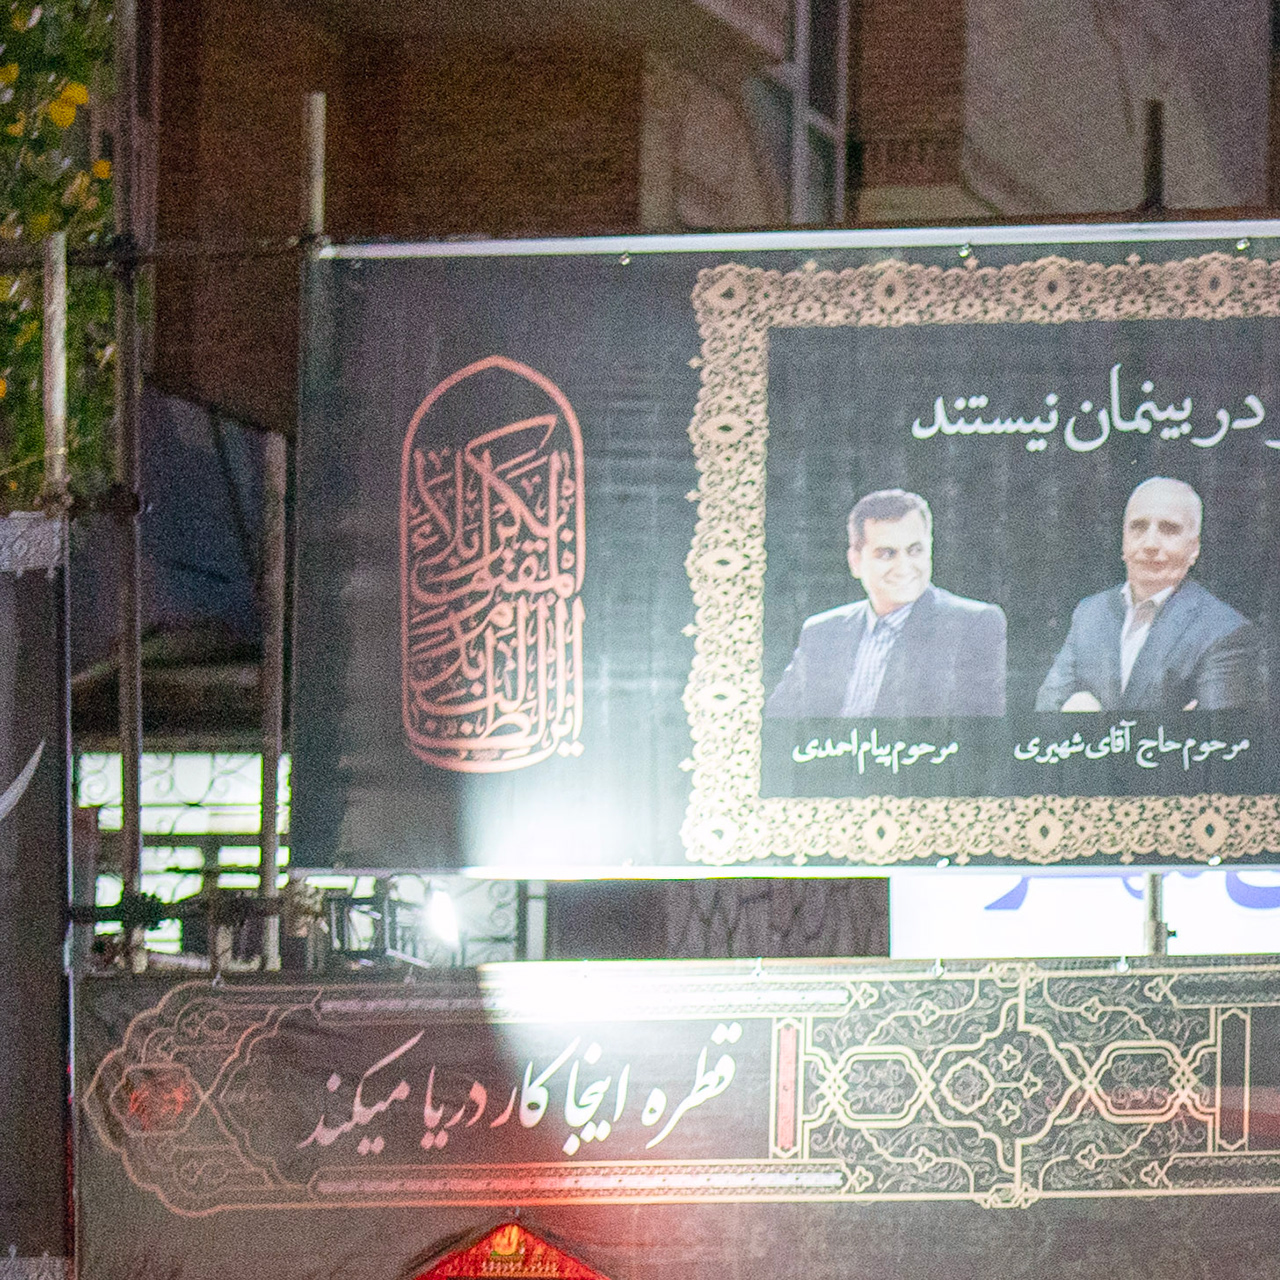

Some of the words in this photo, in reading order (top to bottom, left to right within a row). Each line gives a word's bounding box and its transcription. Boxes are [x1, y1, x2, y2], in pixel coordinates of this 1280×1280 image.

[911, 393, 1058, 452] نیستند
[1063, 363, 1192, 452] بینمان
[1191, 394, 1266, 447] در
[792, 728, 859, 763] احمدی
[857, 729, 894, 774] پیام
[893, 741, 958, 774] مرحوم
[1085, 719, 1136, 760] آقای
[1136, 726, 1182, 768] حاج
[1182, 739, 1250, 770] مرحوم
[421, 1066, 488, 1149] دریا
[490, 1036, 582, 1128] کار
[563, 1042, 630, 1156] اینجا
[641, 1021, 743, 1150] قطره
